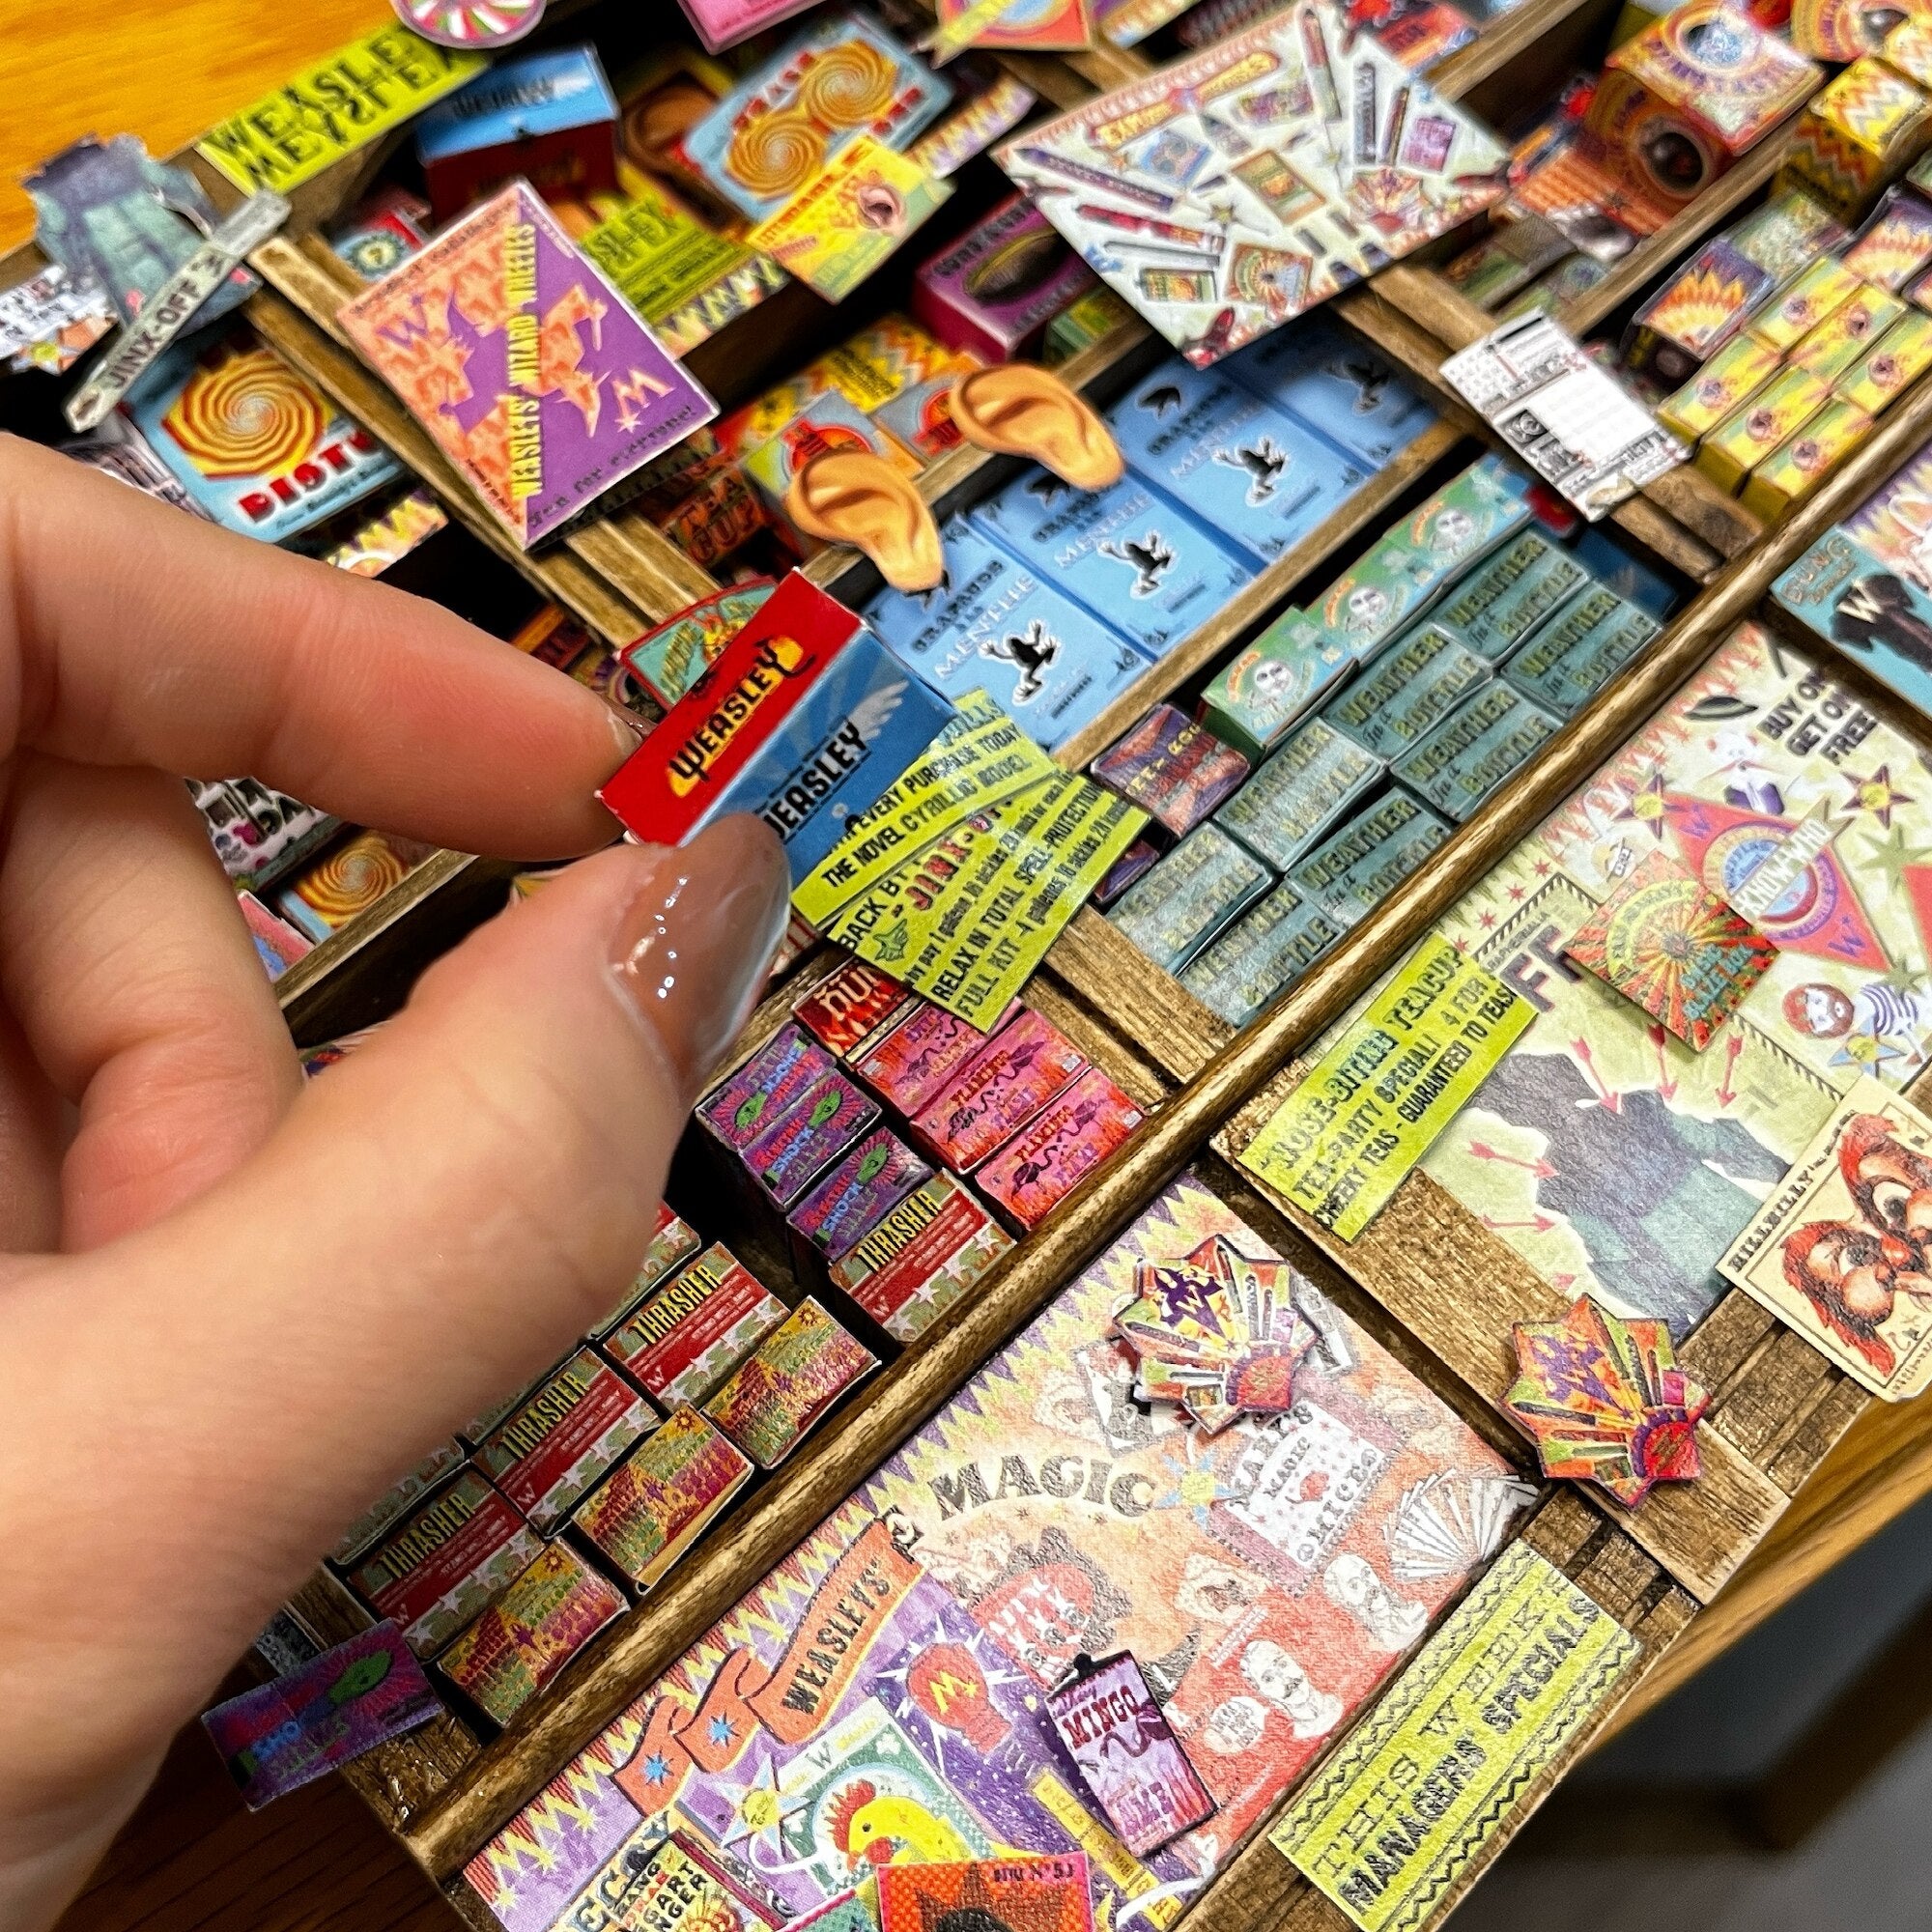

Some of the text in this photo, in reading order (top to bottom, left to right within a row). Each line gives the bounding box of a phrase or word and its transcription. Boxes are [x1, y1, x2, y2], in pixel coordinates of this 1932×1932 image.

[108, 279, 200, 387] JINX-OFF
[507, 315, 540, 387] WIZARD
[1443, 530, 1548, 629] WEATHER
[1495, 558, 1582, 641] BOTTLE
[932, 574, 1036, 678] MENTHE
[1515, 585, 1621, 681] WEATHER
[1570, 609, 1659, 694] BOTTLE
[668, 639, 808, 782] WEASLEY
[1337, 628, 1448, 727] WEATHER
[1390, 651, 1482, 742] BOTTLE
[1755, 693, 1804, 741] BUY
[905, 746, 981, 796] PURCHASE
[977, 722, 1024, 753] TODAY
[1404, 685, 1518, 785] WEATHER
[1459, 711, 1552, 800] BOTTLE
[1782, 713, 1829, 759] GET
[821, 859, 858, 888] THE
[852, 828, 905, 867] NOVEL
[975, 753, 1032, 788] MODEL
[1298, 794, 1420, 889] WEATHER
[837, 896, 886, 952] BACK
[930, 946, 977, 1002] RELAX
[968, 926, 990, 952] IN
[981, 883, 1024, 931] TOTAL
[956, 971, 999, 1017] FULL
[986, 938, 1021, 973] KIT
[1437, 1008, 1461, 1028] 4
[1448, 975, 1489, 1015] FOR
[1292, 1097, 1383, 1202] TEA-PARTY
[1311, 983, 1518, 1229] CHEEKY TEAS GUARANTEED TO TEAS
[821, 1179, 863, 1232] SHOCK
[855, 1187, 944, 1273] THRASHER
[630, 1261, 724, 1348] THRASHER
[497, 1368, 592, 1460] THRASHER
[926, 1453, 1158, 1520] MAGIC
[377, 1489, 476, 1580] THRASHER
[1478, 1592, 1603, 1736] SPECIALS
[1064, 1686, 1141, 1748] MINGO
[1312, 1751, 1423, 1884] THIS
